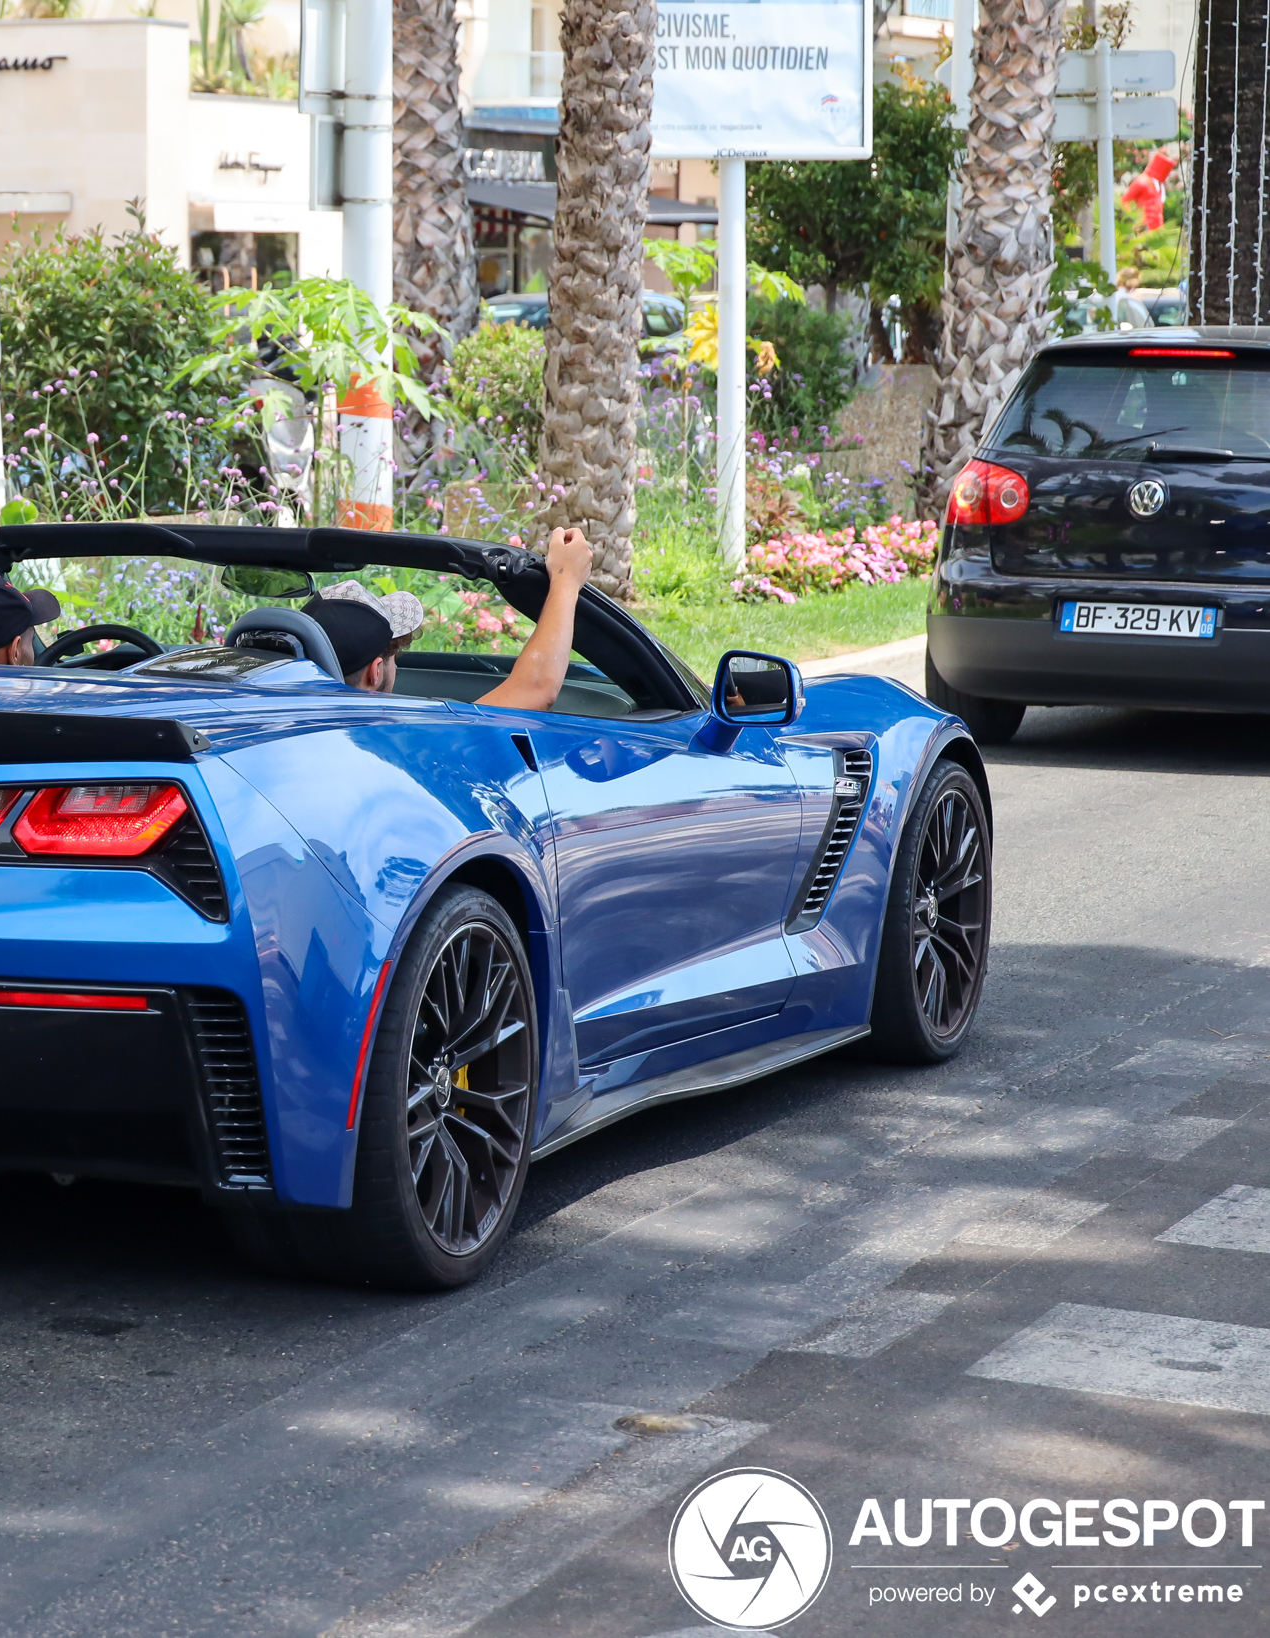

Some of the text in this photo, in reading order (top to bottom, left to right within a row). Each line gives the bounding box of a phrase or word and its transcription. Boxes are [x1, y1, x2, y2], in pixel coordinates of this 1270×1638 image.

[655, 13, 736, 40] CIVISME,
[654, 45, 829, 71] ST MON QUOTIDIEN
[713, 147, 768, 158] JCDecaux
[1076, 605, 1200, 633] BF-329-KV
